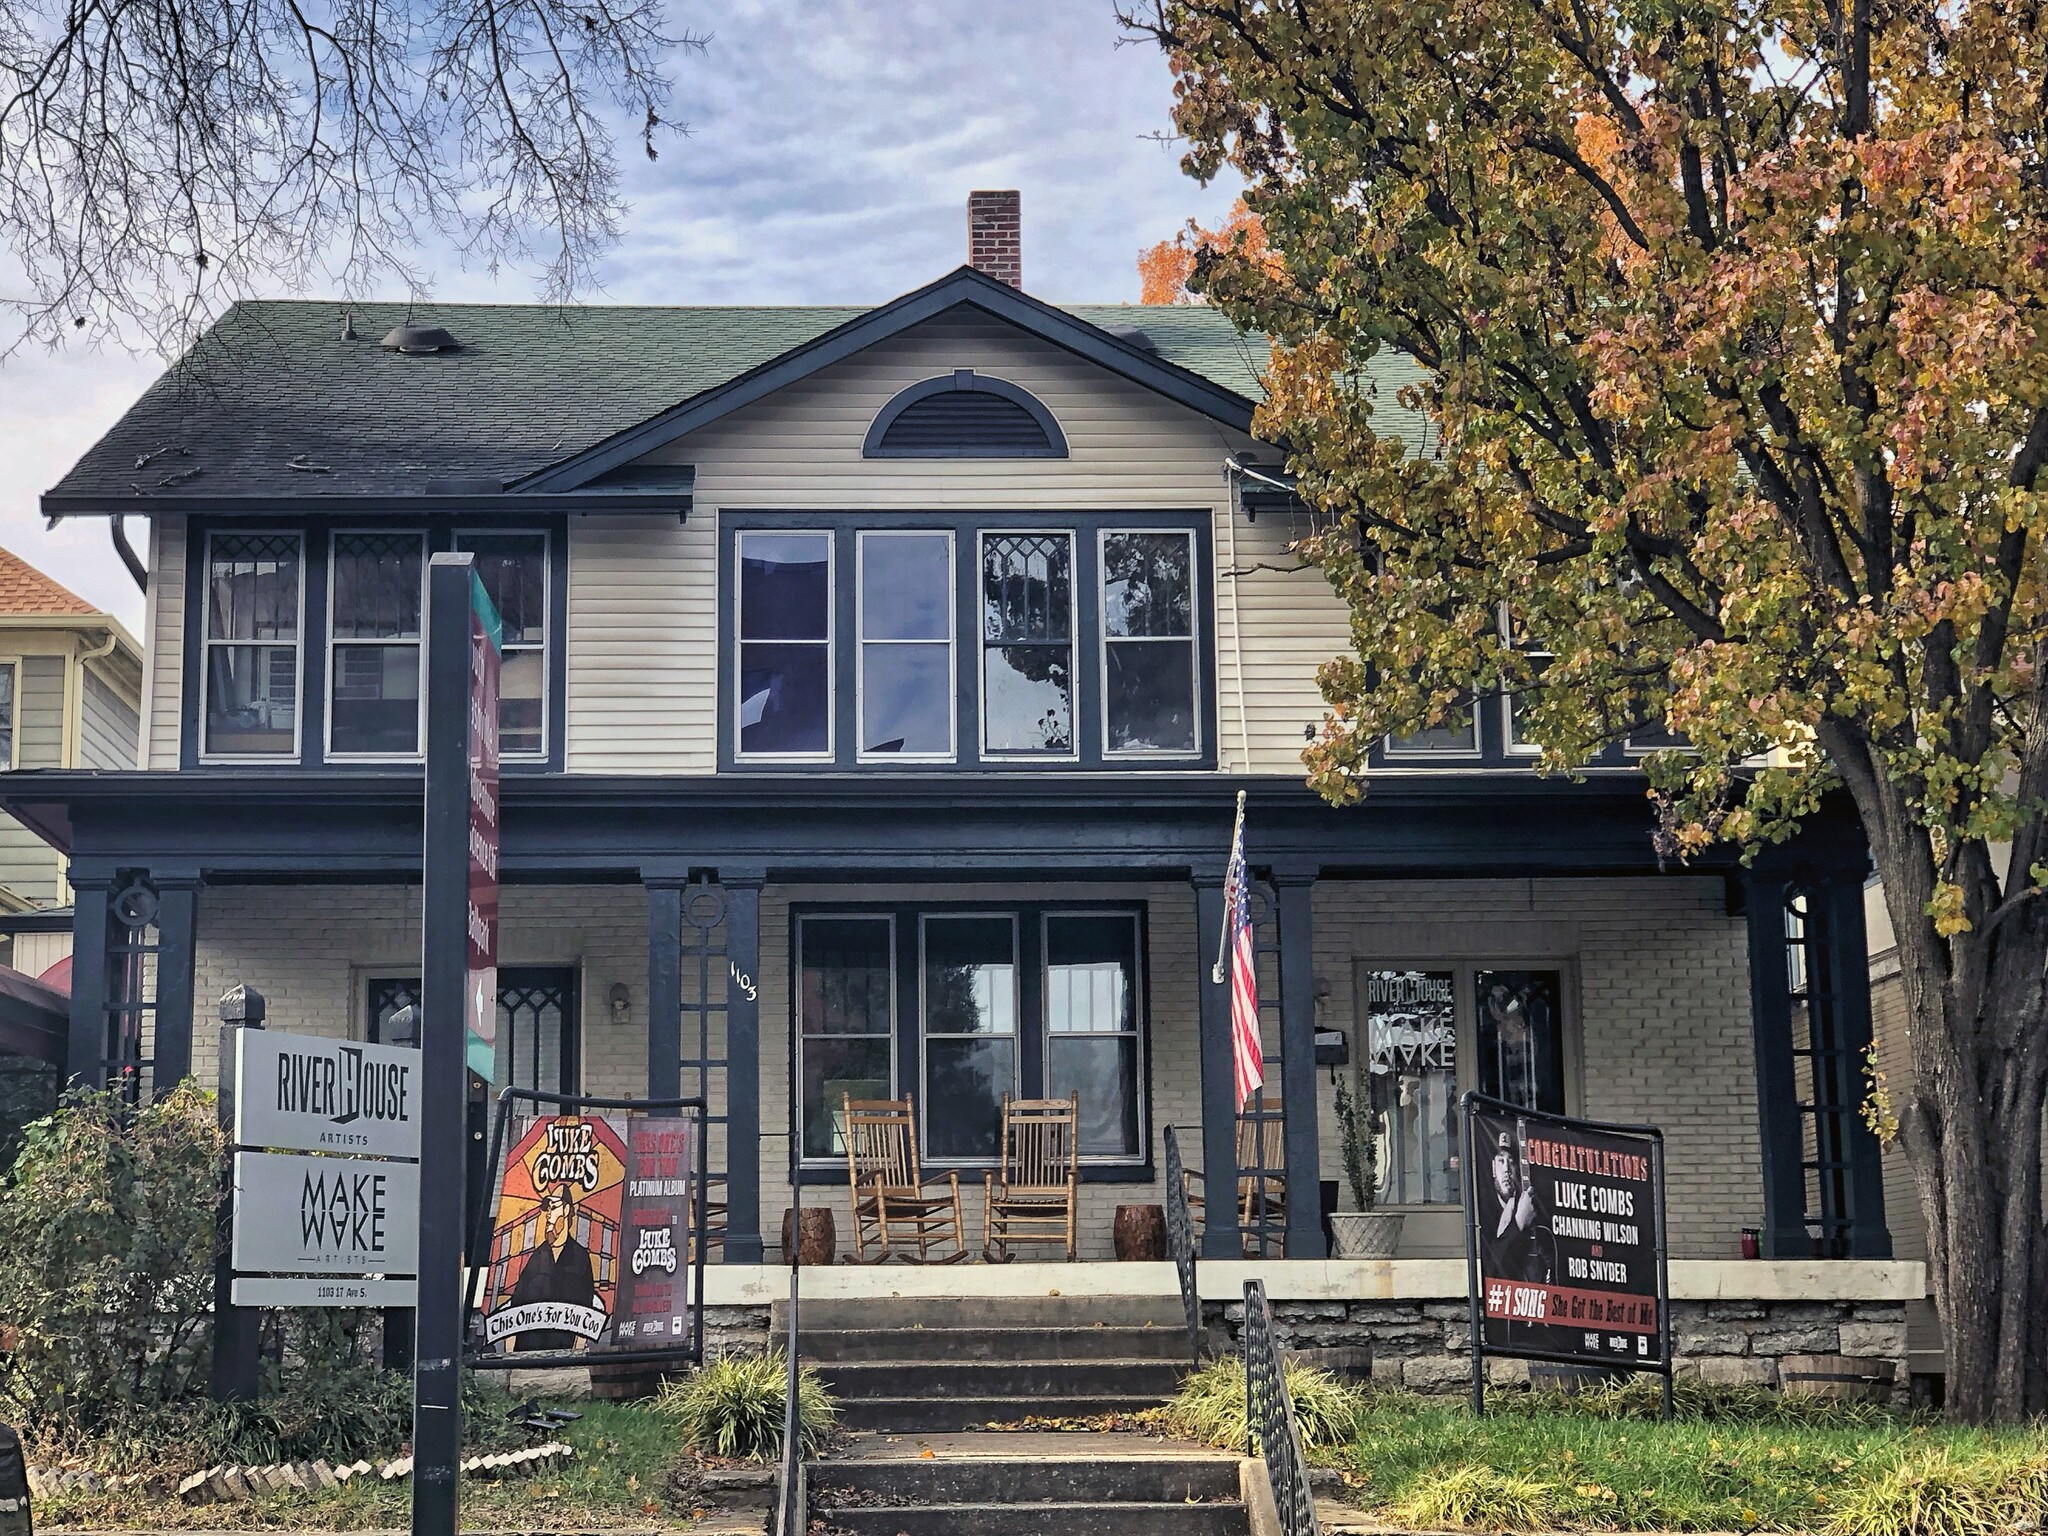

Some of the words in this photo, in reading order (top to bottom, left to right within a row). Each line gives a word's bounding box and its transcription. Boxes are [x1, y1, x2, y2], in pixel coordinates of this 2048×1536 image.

[471, 696, 493, 755] ashville
[730, 961, 757, 1001] 1103
[1369, 1018, 1454, 1042] MAKE
[320, 1132, 368, 1145] ARTISTS
[546, 1123, 593, 1153] LUKE
[532, 1152, 599, 1191] COMBS
[1527, 1138, 1648, 1182] CONGRATULATIONS
[301, 1169, 386, 1213] MAKE
[629, 1180, 662, 1197] PLATINUM
[663, 1180, 686, 1196] ALBUM
[1554, 1180, 1588, 1211] LUKE
[1590, 1186, 1634, 1217] COMBS
[639, 1228, 671, 1249] LUKE
[1552, 1214, 1601, 1242] CHANNING
[1604, 1220, 1639, 1246] WILSON
[316, 1255, 366, 1265] ARTISTS
[632, 1248, 677, 1275] COMBS
[1568, 1257, 1588, 1279] ROB
[1590, 1260, 1627, 1284] SNYDER
[318, 1286, 334, 1298] 1103
[336, 1286, 344, 1298] 17
[346, 1287, 358, 1298] Ave
[1488, 1284, 1512, 1315] #1
[1513, 1287, 1548, 1319] SONG
[491, 1316, 514, 1335] This
[517, 1306, 543, 1326] One's
[545, 1306, 562, 1323] For
[565, 1307, 581, 1326] You
[582, 1312, 599, 1333] Too
[1552, 1294, 1568, 1318] She
[1571, 1296, 1586, 1320] Got
[1589, 1299, 1603, 1322] the
[1605, 1299, 1625, 1325] Best
[1627, 1303, 1636, 1326] of
[1640, 1303, 1653, 1326] Me
[1585, 1333, 1600, 1342] MAKE
